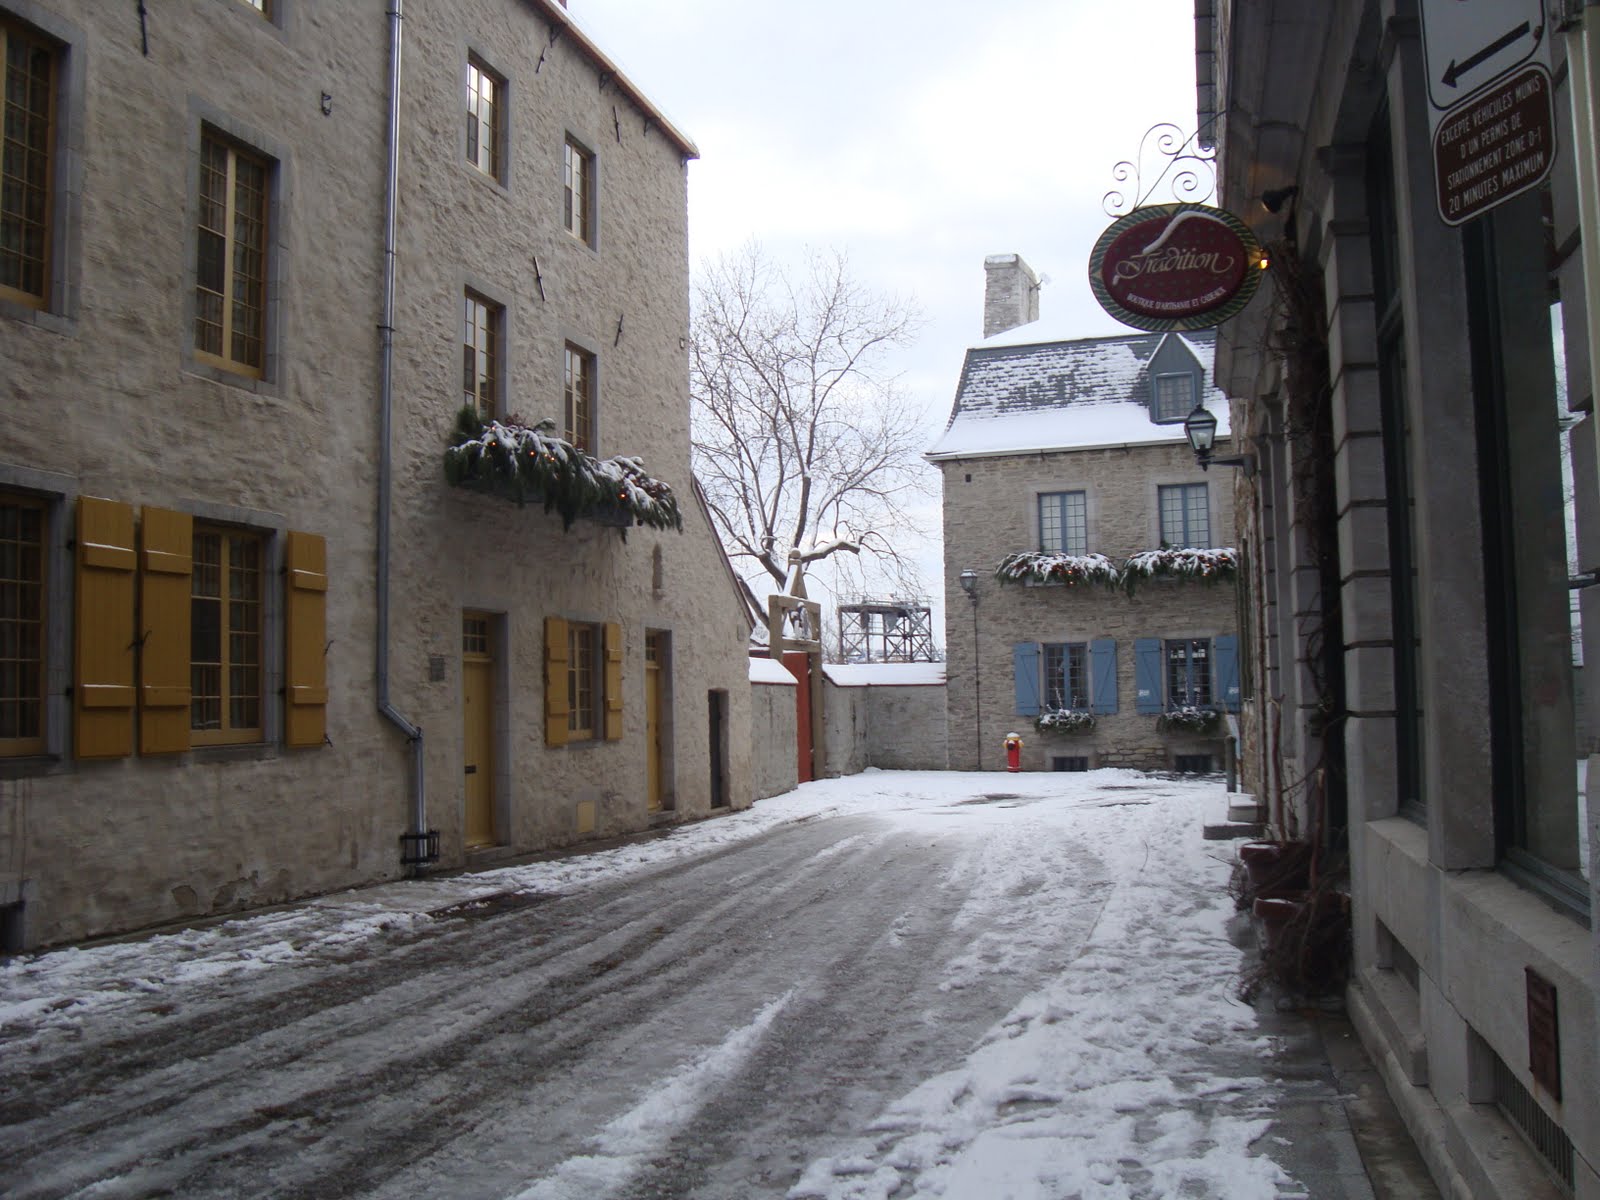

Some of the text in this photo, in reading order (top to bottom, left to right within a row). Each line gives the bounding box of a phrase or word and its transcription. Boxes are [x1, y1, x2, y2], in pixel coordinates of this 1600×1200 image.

[1441, 74, 1541, 146] EXCEPTÉ VÉHICULES MUNIS
[1460, 111, 1522, 159] D'UN PERMIS DE
[1447, 147, 1502, 190] STATIONNEMENT
[1505, 134, 1526, 160] ZONE
[1448, 151, 1544, 214] 20 MINUTES MAXIMUM
[1115, 246, 1235, 279] Tradition
[1126, 292, 1155, 309] BOUTIQUE
[1191, 298, 1199, 307] ET
